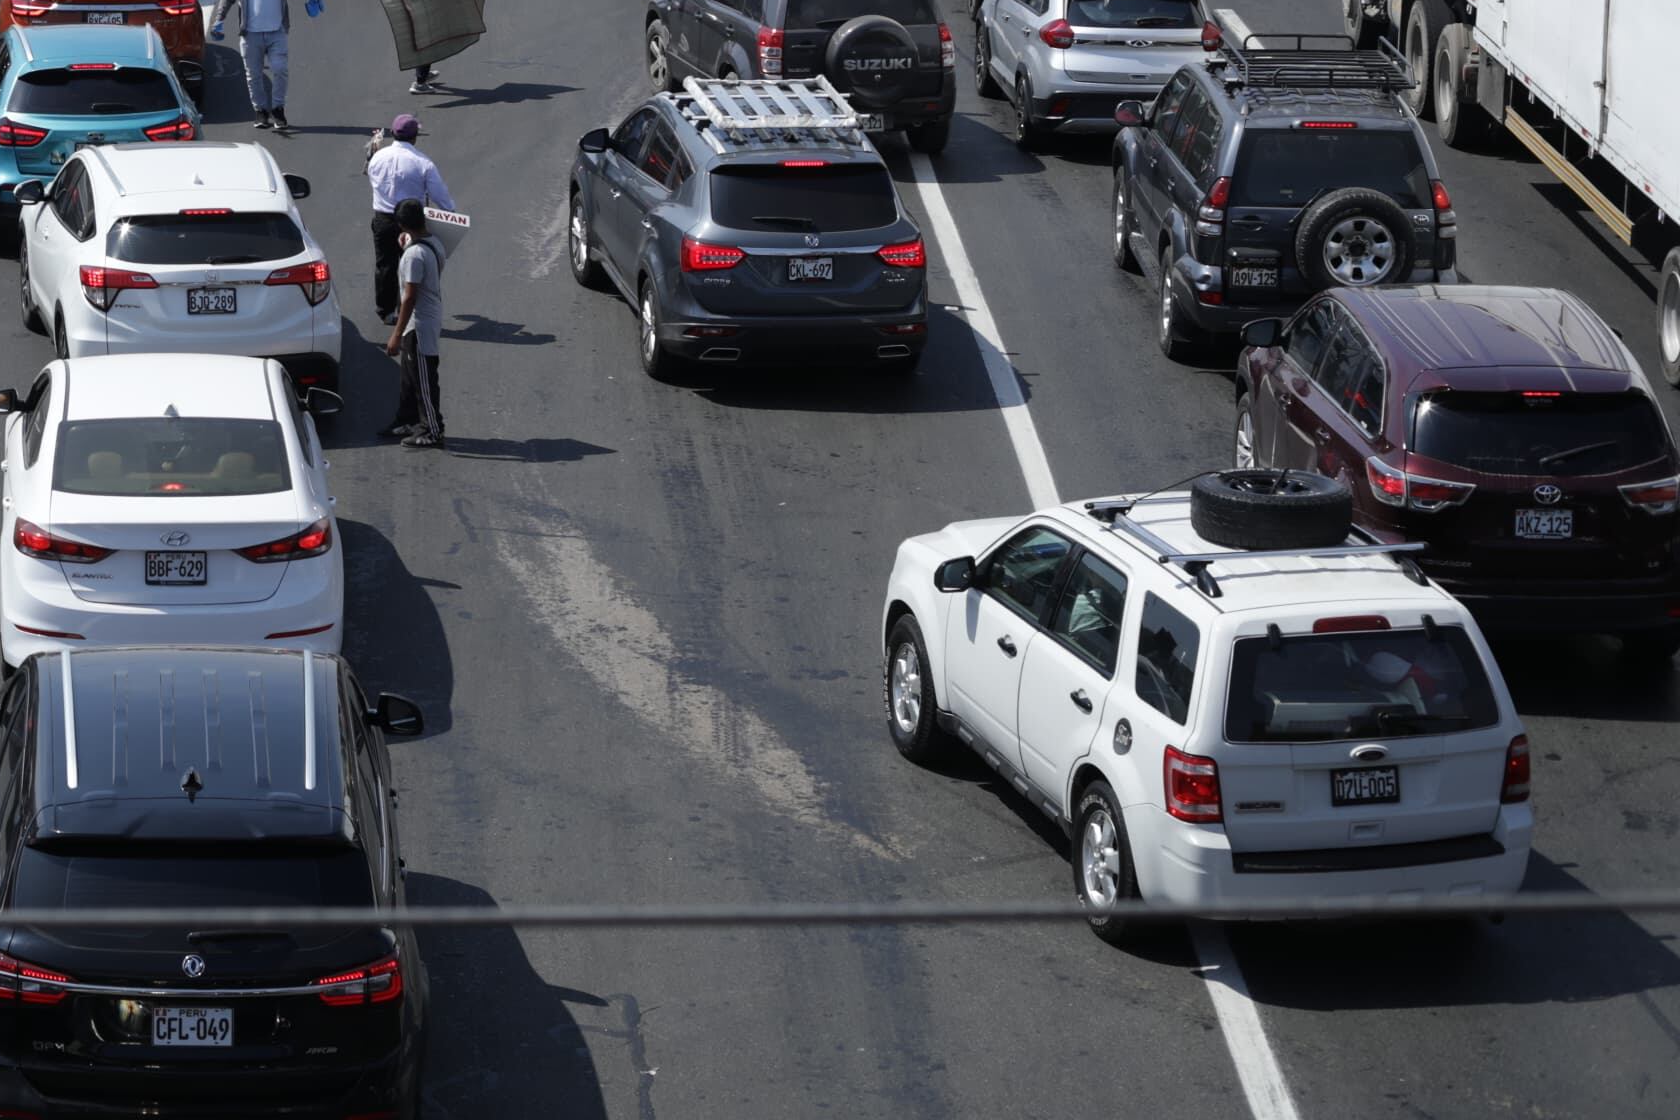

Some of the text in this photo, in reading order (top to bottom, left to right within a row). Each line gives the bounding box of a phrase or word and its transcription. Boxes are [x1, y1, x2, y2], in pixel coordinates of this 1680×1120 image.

[843, 58, 913, 71] SUZUKI
[428, 209, 468, 226] SAYAN
[789, 263, 832, 279] CKL-697
[1516, 513, 1572, 533] AKZ-125
[148, 560, 203, 578] BBF-629
[179, 1008, 207, 1018] PERU
[155, 1018, 230, 1041] CFL-049
